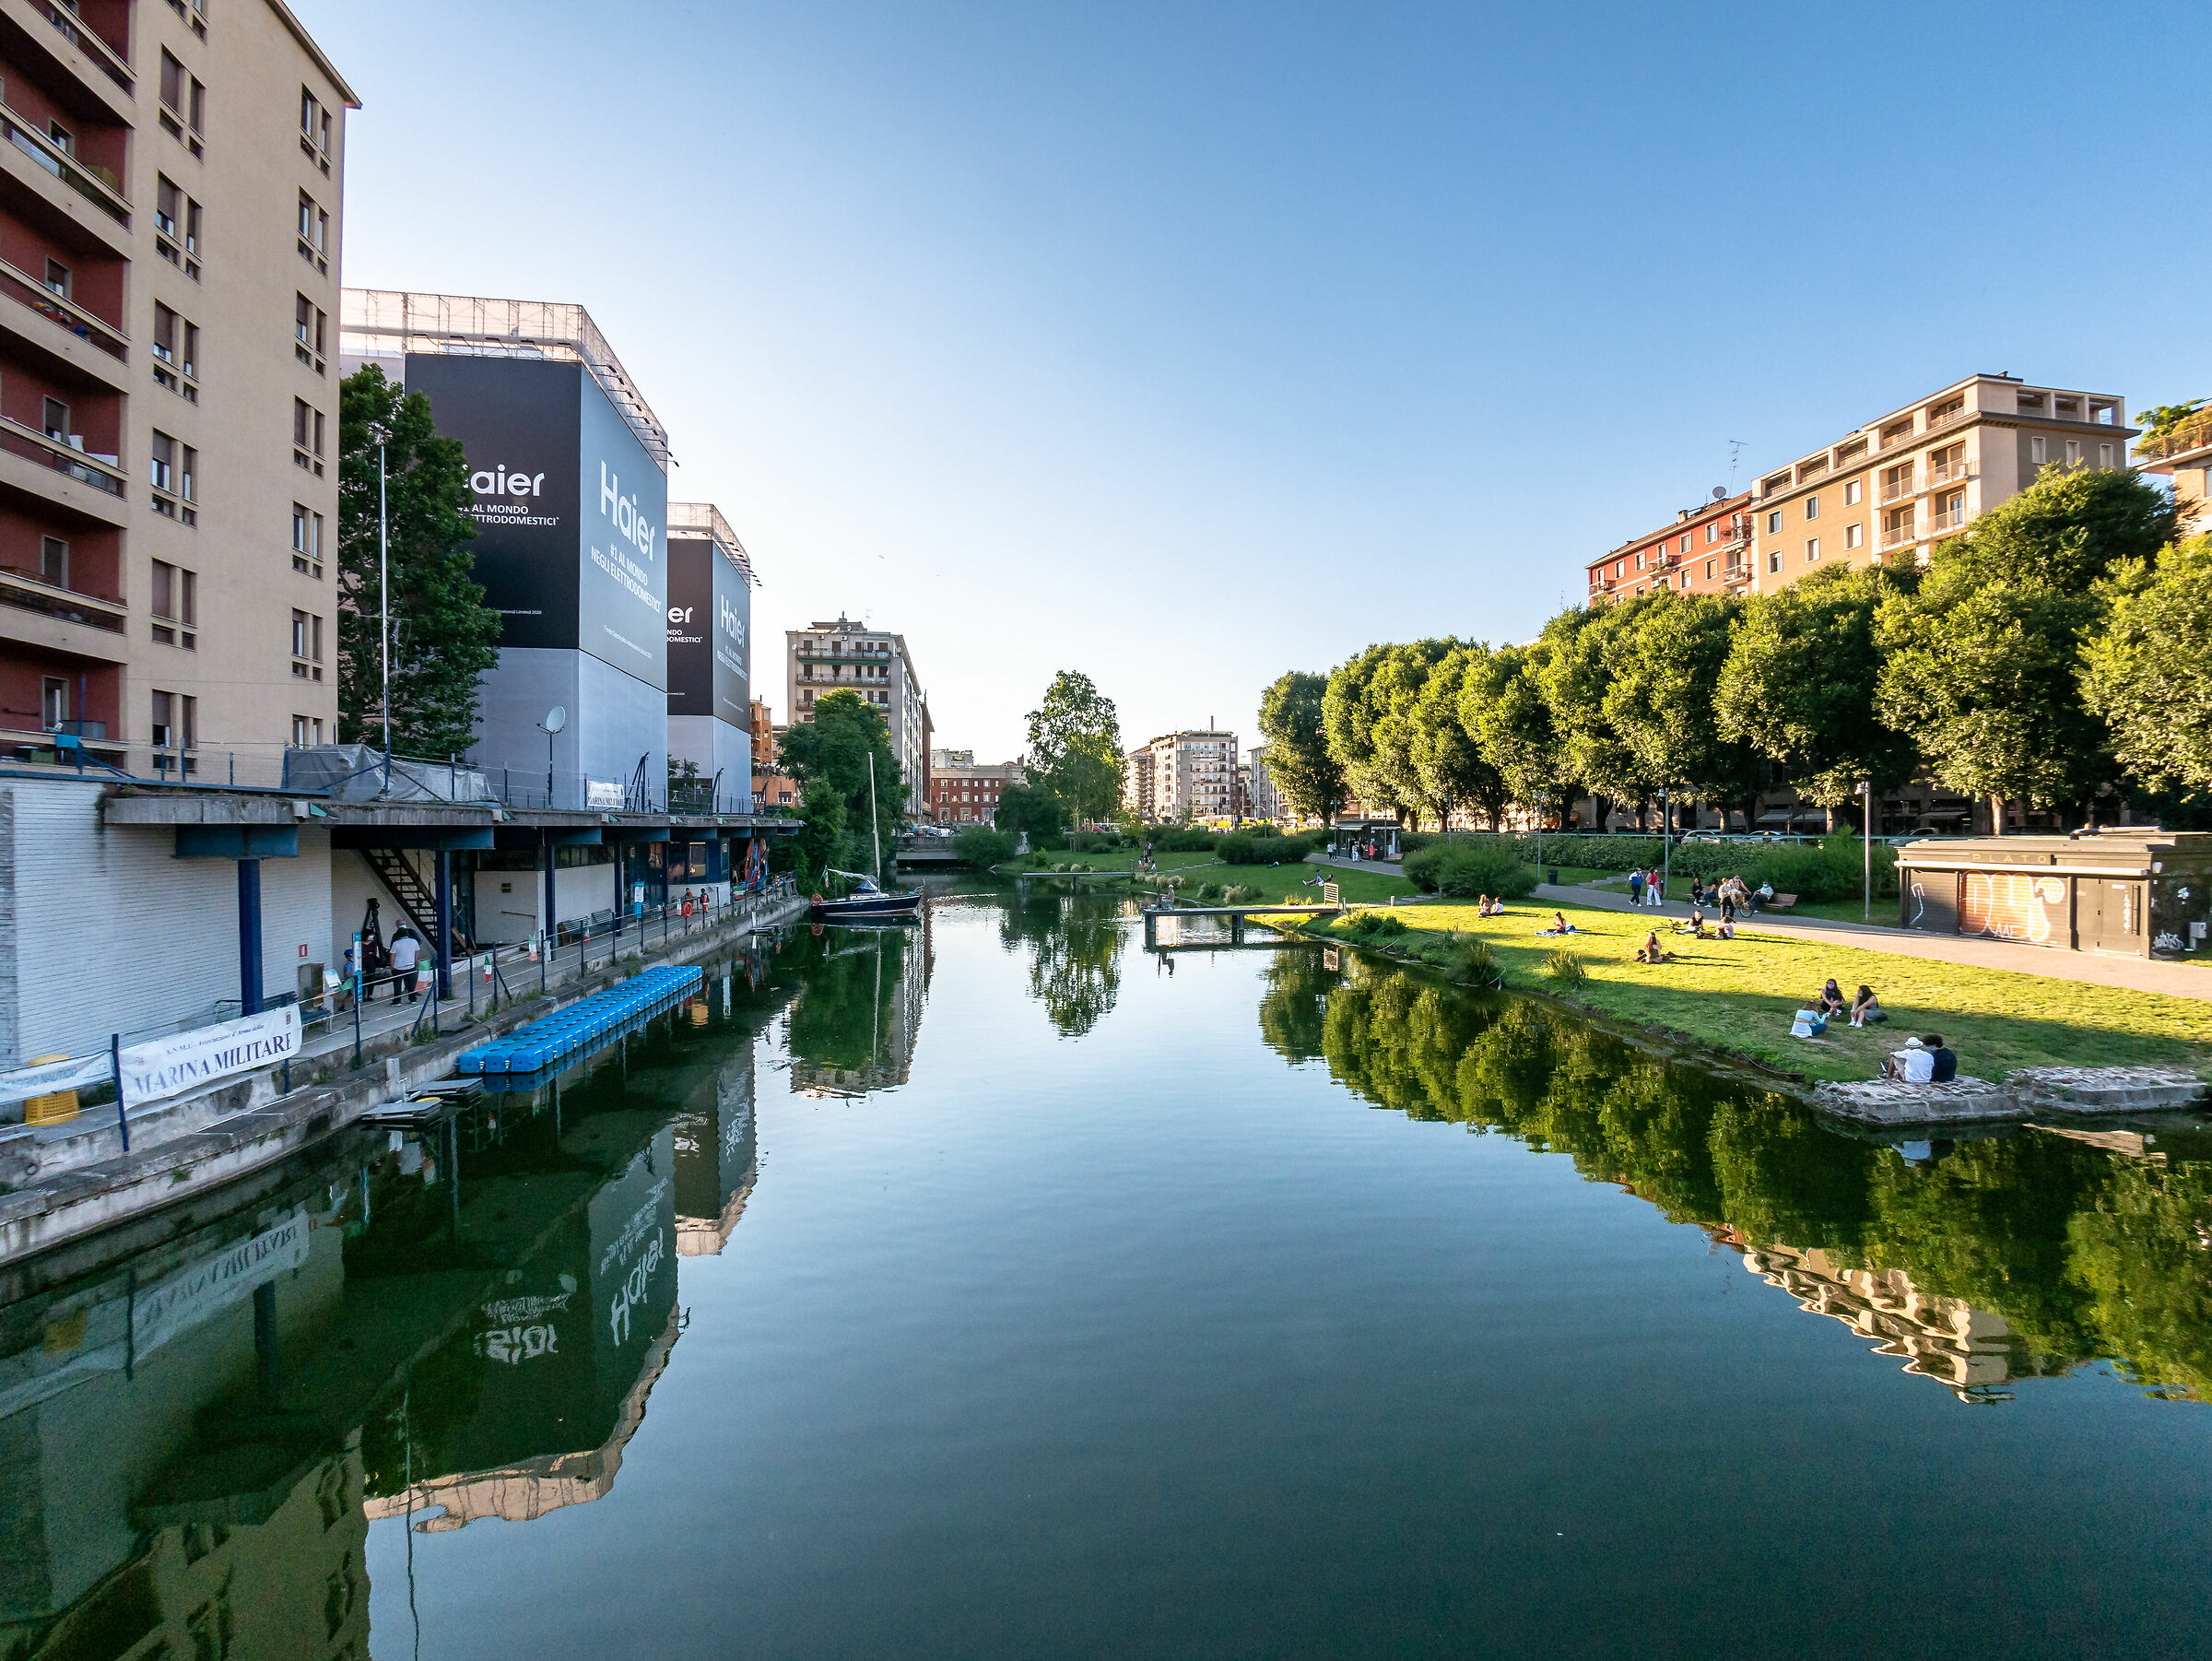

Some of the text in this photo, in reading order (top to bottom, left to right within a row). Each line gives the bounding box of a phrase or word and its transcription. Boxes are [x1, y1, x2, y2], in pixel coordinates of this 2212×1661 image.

[463, 464, 546, 497] aier
[471, 504, 485, 512] AL
[487, 504, 529, 514] MONDO
[601, 459, 655, 561] Haier
[591, 545, 610, 573] NEGLI
[610, 543, 648, 586] #1 AL MONDO
[721, 594, 746, 648] Haier
[1972, 854, 2046, 864] PLATO
[135, 1031, 292, 1094] MARINA MILITARE
